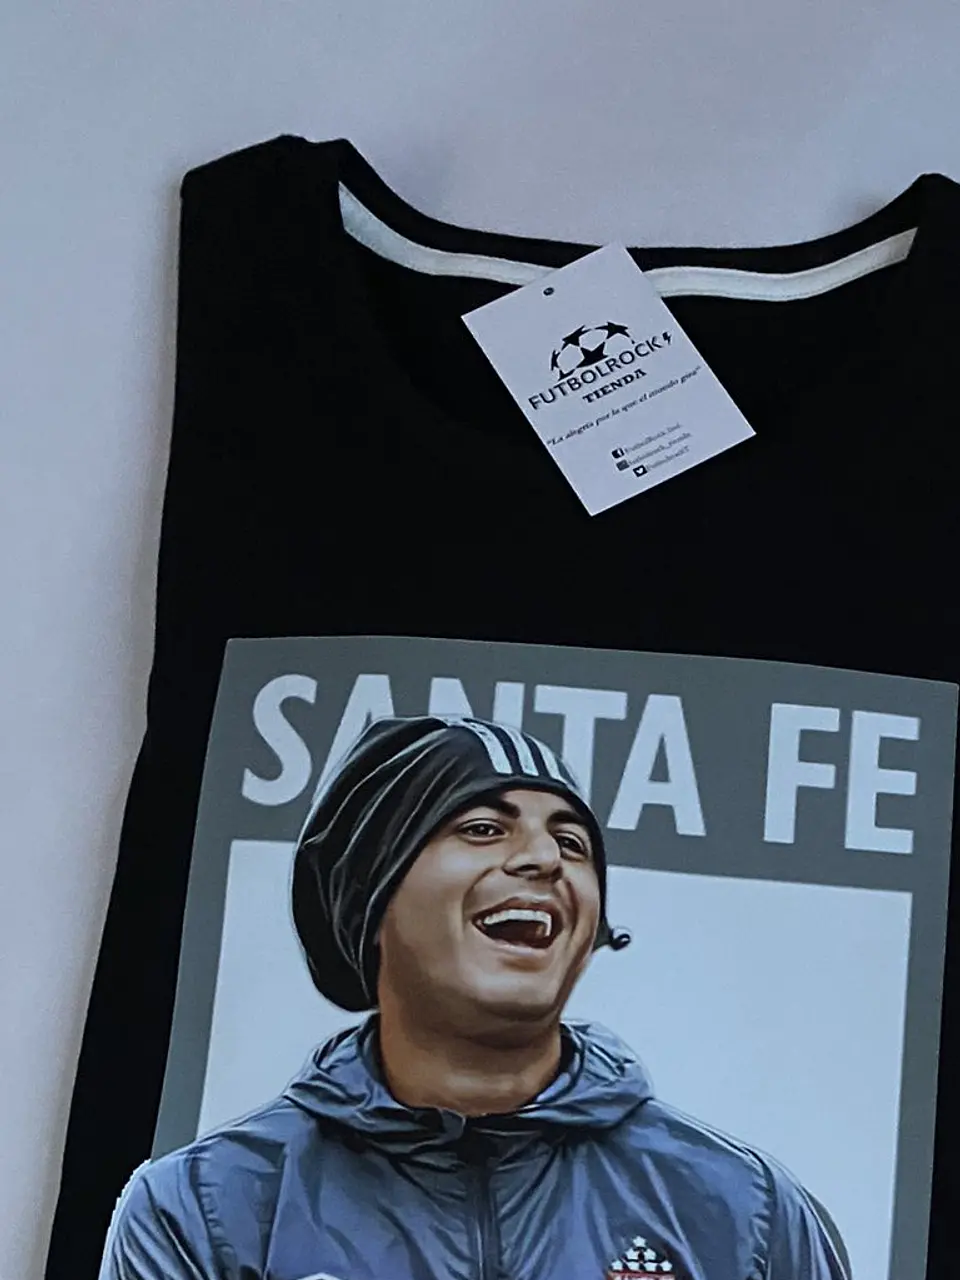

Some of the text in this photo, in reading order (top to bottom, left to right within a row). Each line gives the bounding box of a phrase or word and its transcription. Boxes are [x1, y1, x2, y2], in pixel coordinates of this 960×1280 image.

[527, 336, 663, 410] FUTBOLROCK
[582, 368, 647, 404] TIENDA
[241, 673, 920, 854] SATA FE
